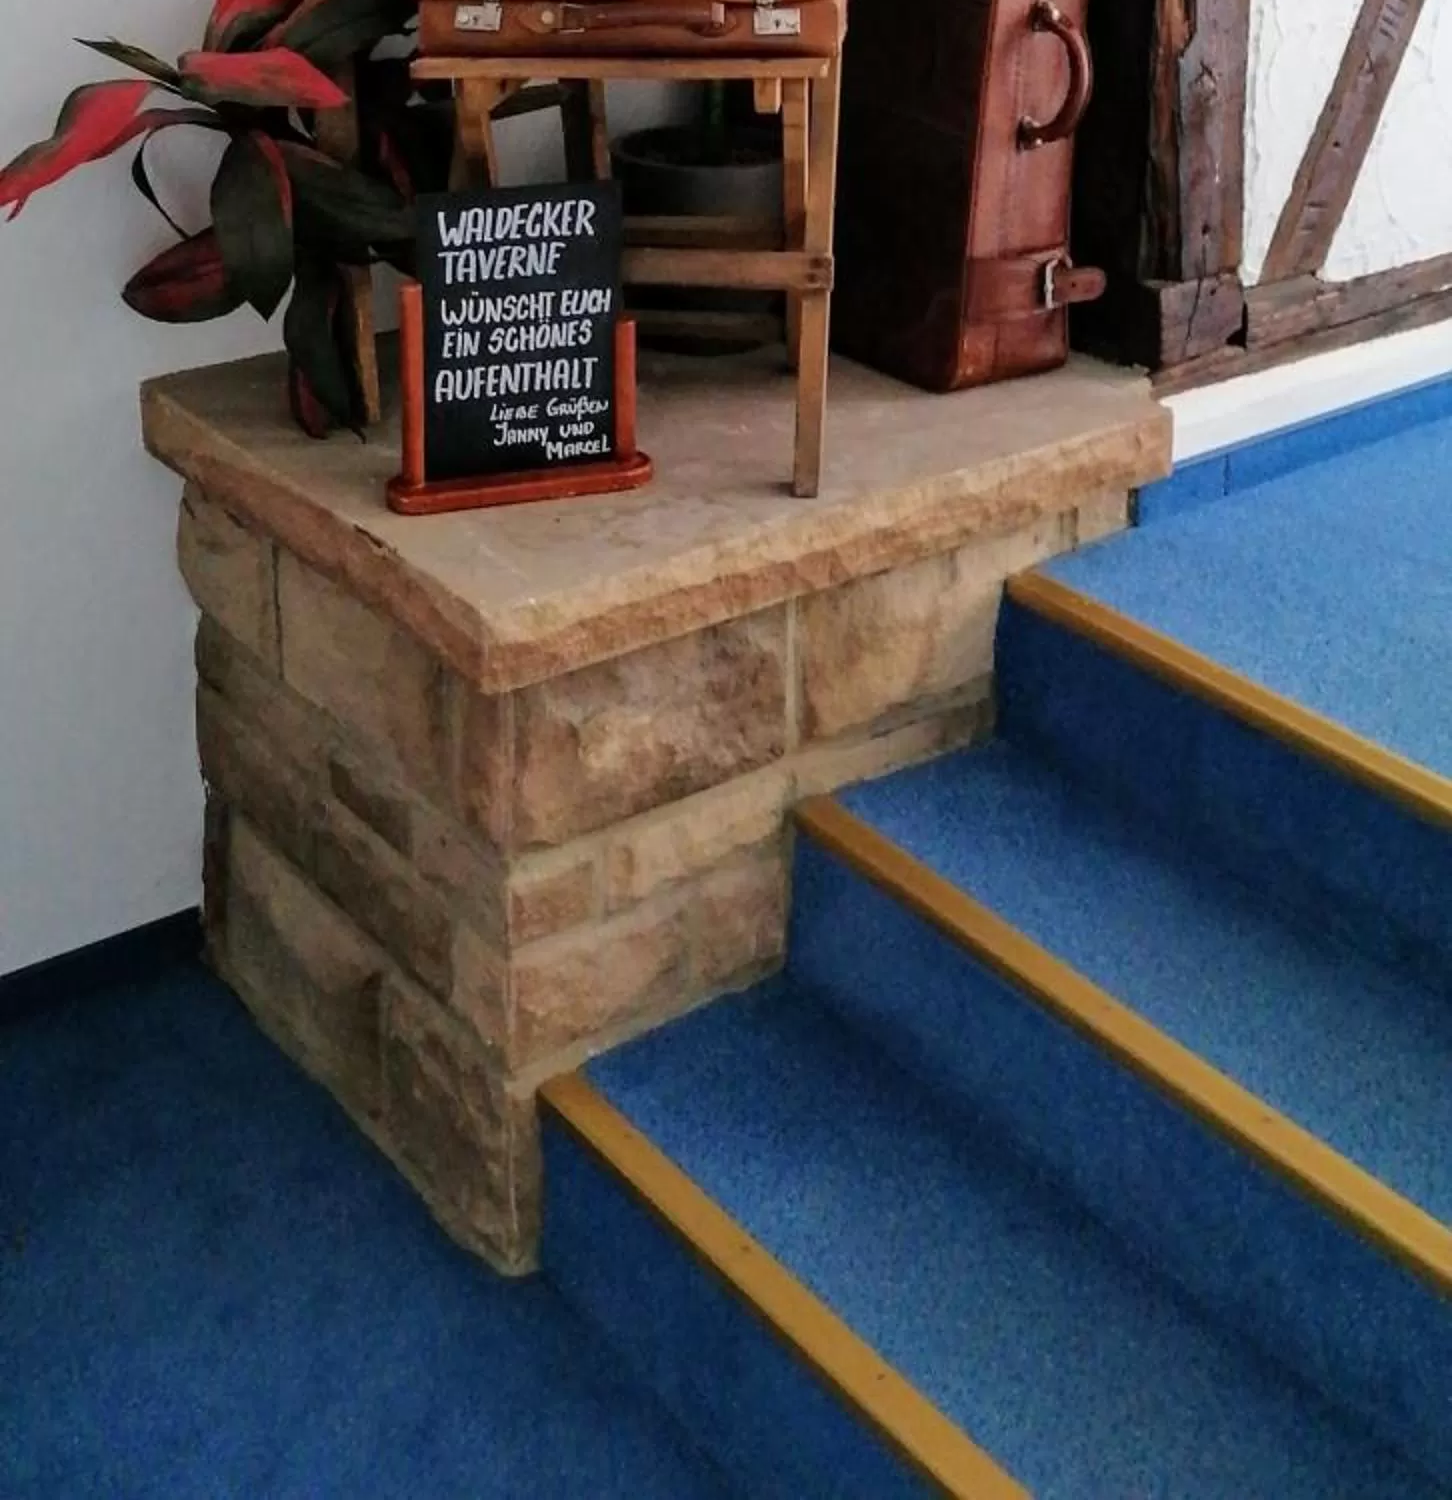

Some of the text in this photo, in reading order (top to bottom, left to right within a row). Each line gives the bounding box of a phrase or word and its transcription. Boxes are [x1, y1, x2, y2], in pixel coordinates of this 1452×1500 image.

[437, 199, 596, 247] WALDECKER
[437, 242, 567, 284] TAVERNE
[441, 288, 612, 325] WÜNSCHT EUCH
[488, 317, 593, 354] SCHÖNES
[435, 357, 599, 403] AUFENTHALT
[546, 434, 611, 460] MARCEL
[559, 421, 595, 438] UND
